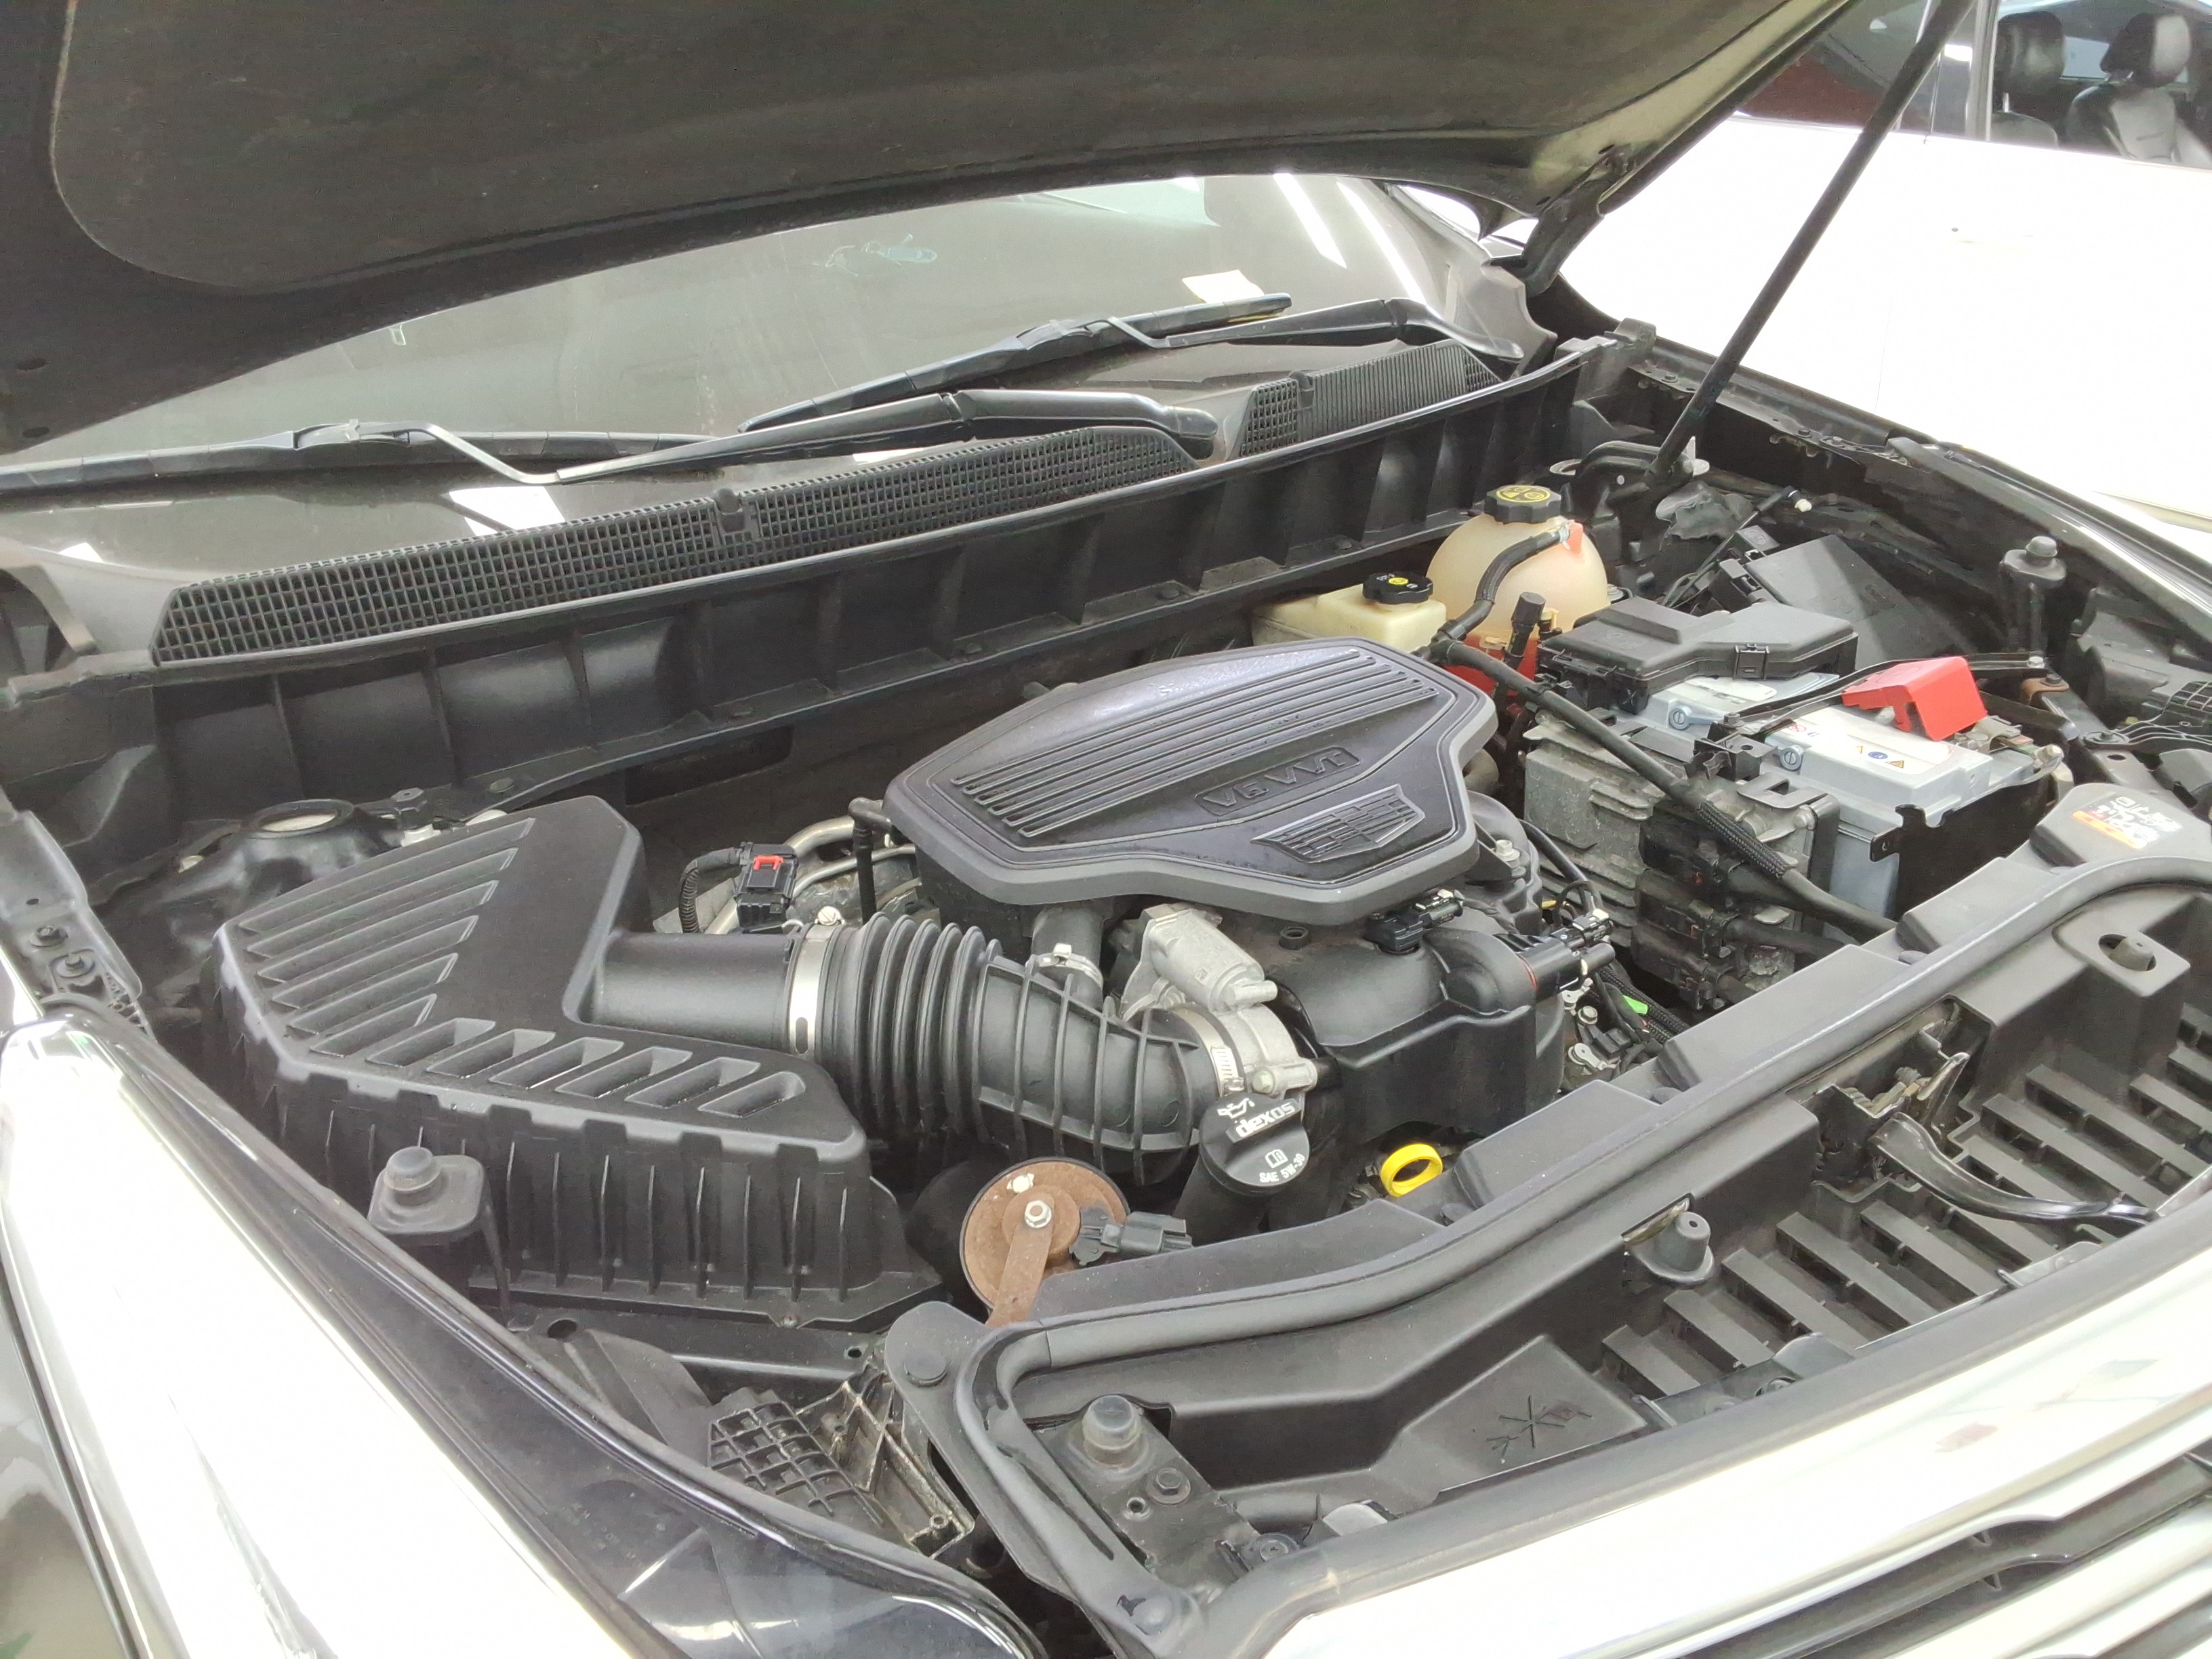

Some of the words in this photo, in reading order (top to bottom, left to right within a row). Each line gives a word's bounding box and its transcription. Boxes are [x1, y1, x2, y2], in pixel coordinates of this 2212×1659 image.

[1202, 780, 1269, 807] V6
[1235, 1101, 1295, 1137] dexos
[1258, 1170, 1279, 1183] SAE
[1281, 1153, 1305, 1178] 5W-30
